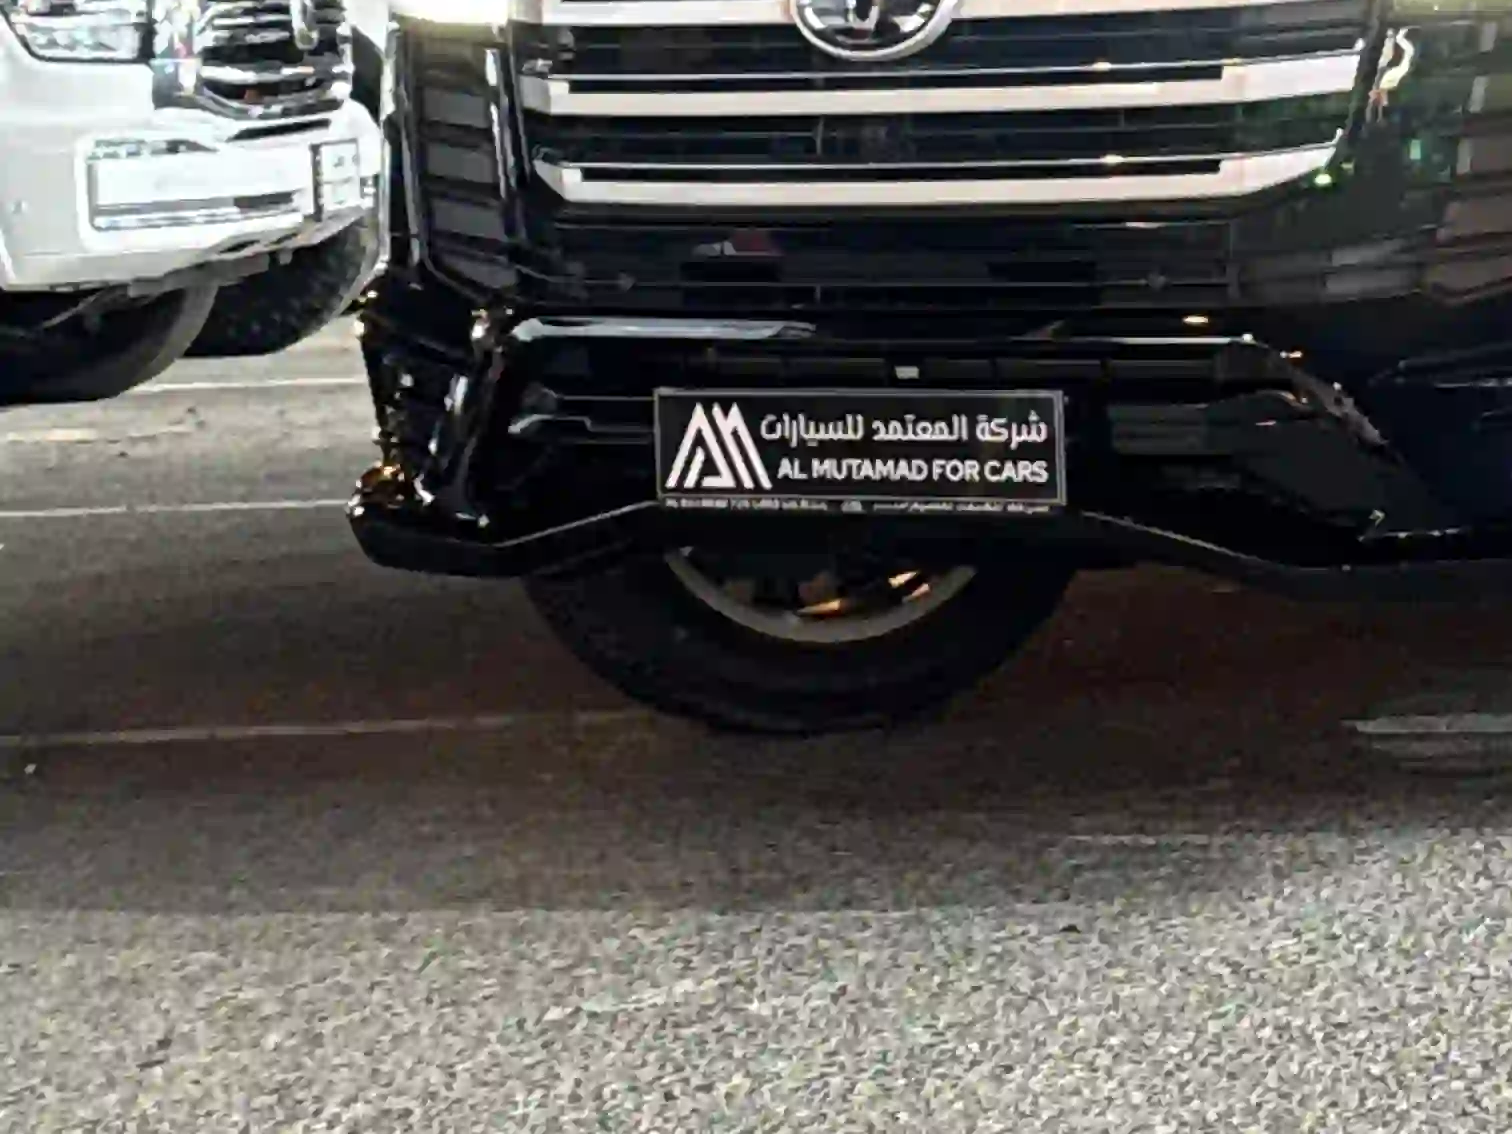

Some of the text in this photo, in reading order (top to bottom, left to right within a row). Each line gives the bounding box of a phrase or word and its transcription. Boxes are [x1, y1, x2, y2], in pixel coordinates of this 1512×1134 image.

[760, 409, 1048, 450] شركة المعتمد للسيارات
[777, 457, 1049, 484] AL MUTAMAD FOR CARS
